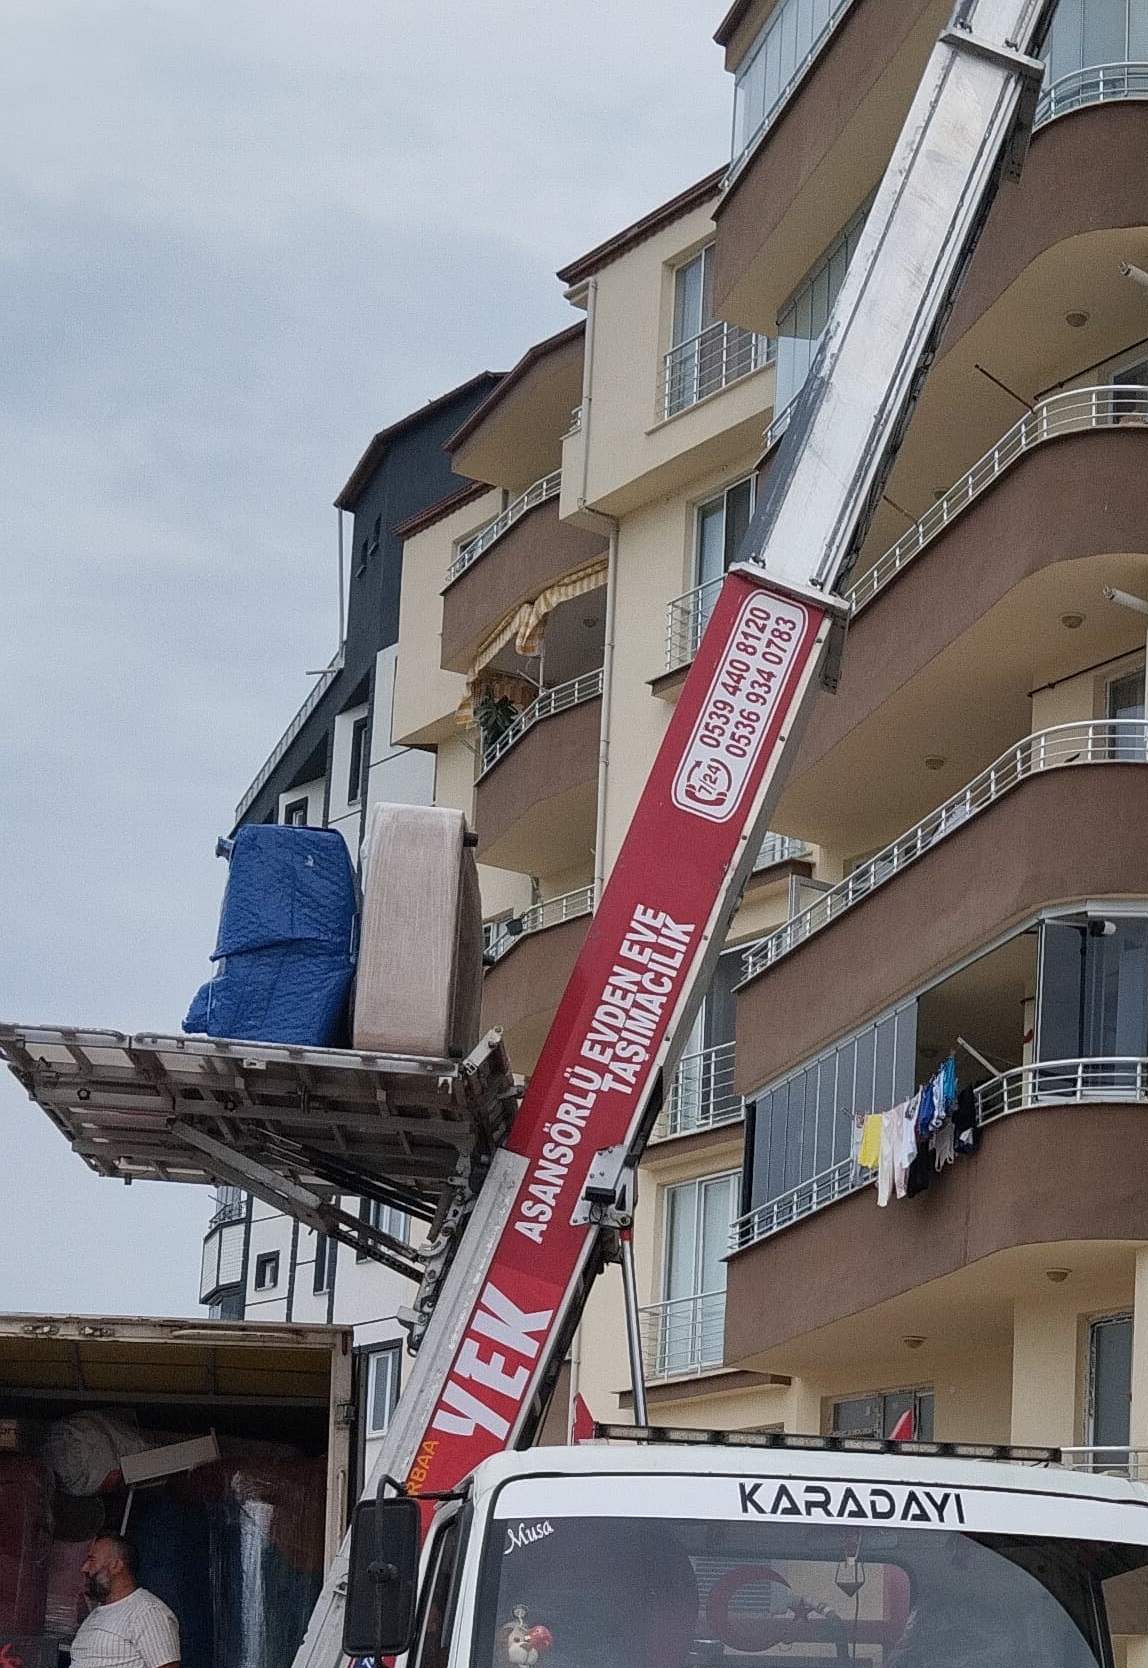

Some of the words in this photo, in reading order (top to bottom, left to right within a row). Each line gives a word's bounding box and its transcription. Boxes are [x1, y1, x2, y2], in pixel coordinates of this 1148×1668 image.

[735, 606, 771, 657] 8120
[761, 615, 797, 666] 0783
[720, 658, 751, 698] 440
[745, 667, 778, 706] 934
[699, 699, 735, 749] 0539
[725, 708, 761, 759] 0536
[600, 914, 696, 1095] TAŞIMACILIK
[513, 1066, 603, 1245] ASANSÖRLÜ
[580, 965, 642, 1066] EVDEN
[619, 903, 667, 966] EVE
[431, 1280, 555, 1442] YEK
[406, 1440, 440, 1497] RBAA
[739, 1482, 966, 1526] KARADAYI
[503, 1520, 555, 1556] Musa
